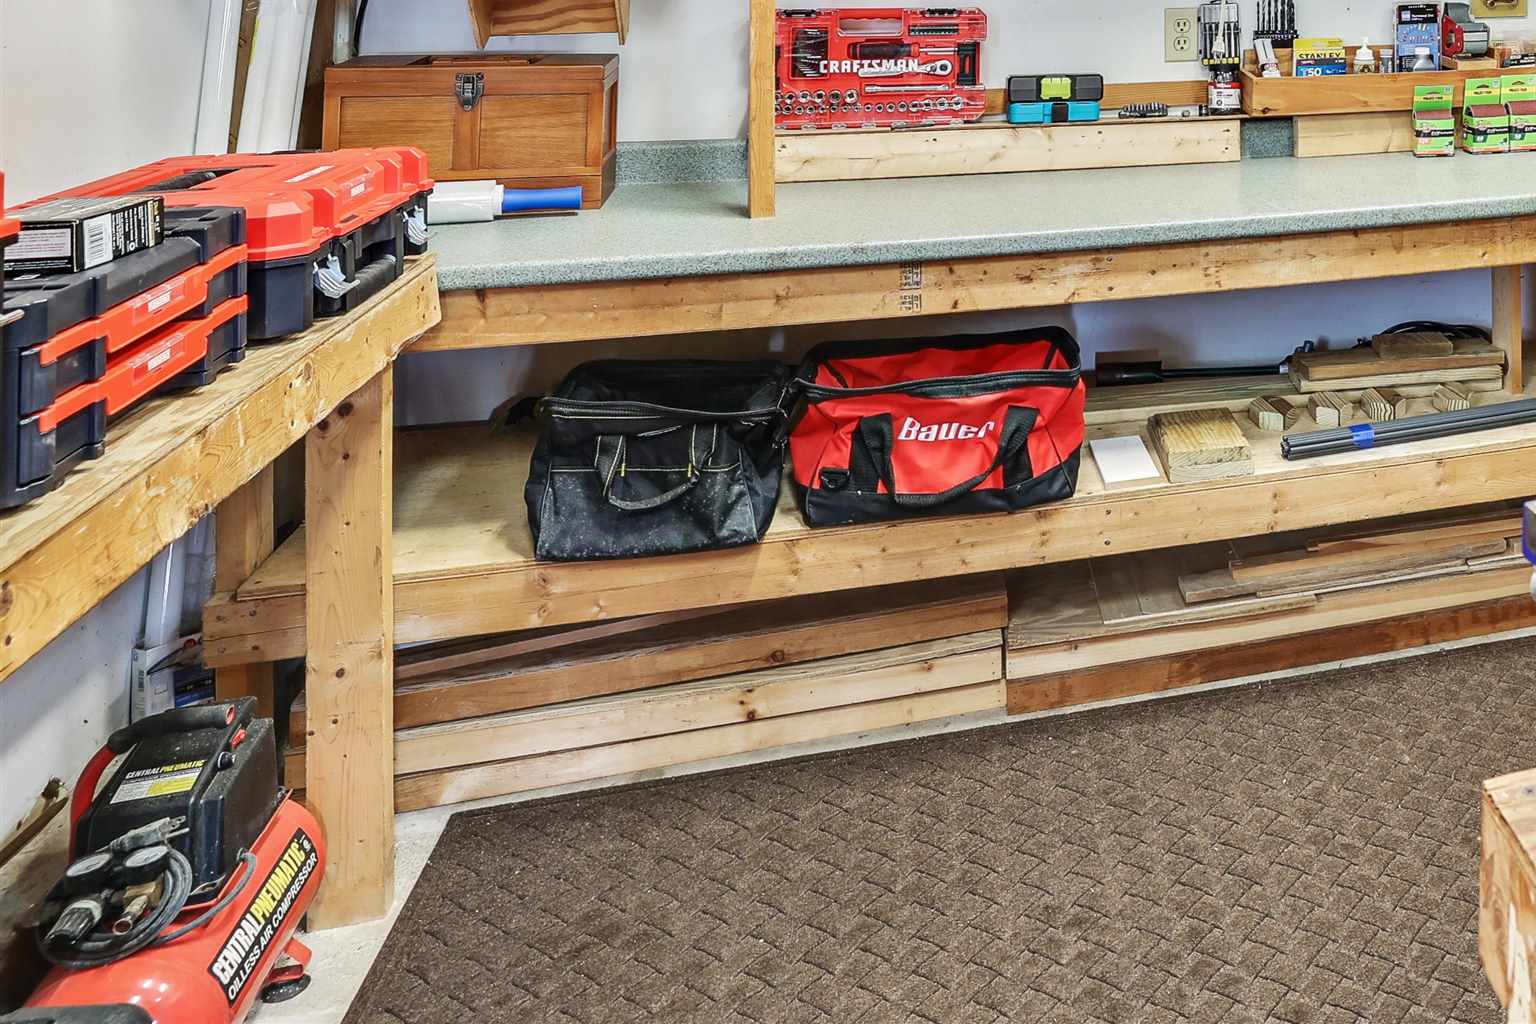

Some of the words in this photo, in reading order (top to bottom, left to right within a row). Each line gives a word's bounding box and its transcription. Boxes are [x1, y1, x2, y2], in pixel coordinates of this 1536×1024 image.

[819, 59, 919, 74] CRAFTSMAN
[897, 416, 995, 442] Bauer
[228, 945, 260, 1000] OILLESS
[260, 925, 274, 948] AIR
[272, 852, 317, 927] COMPRESSOR
